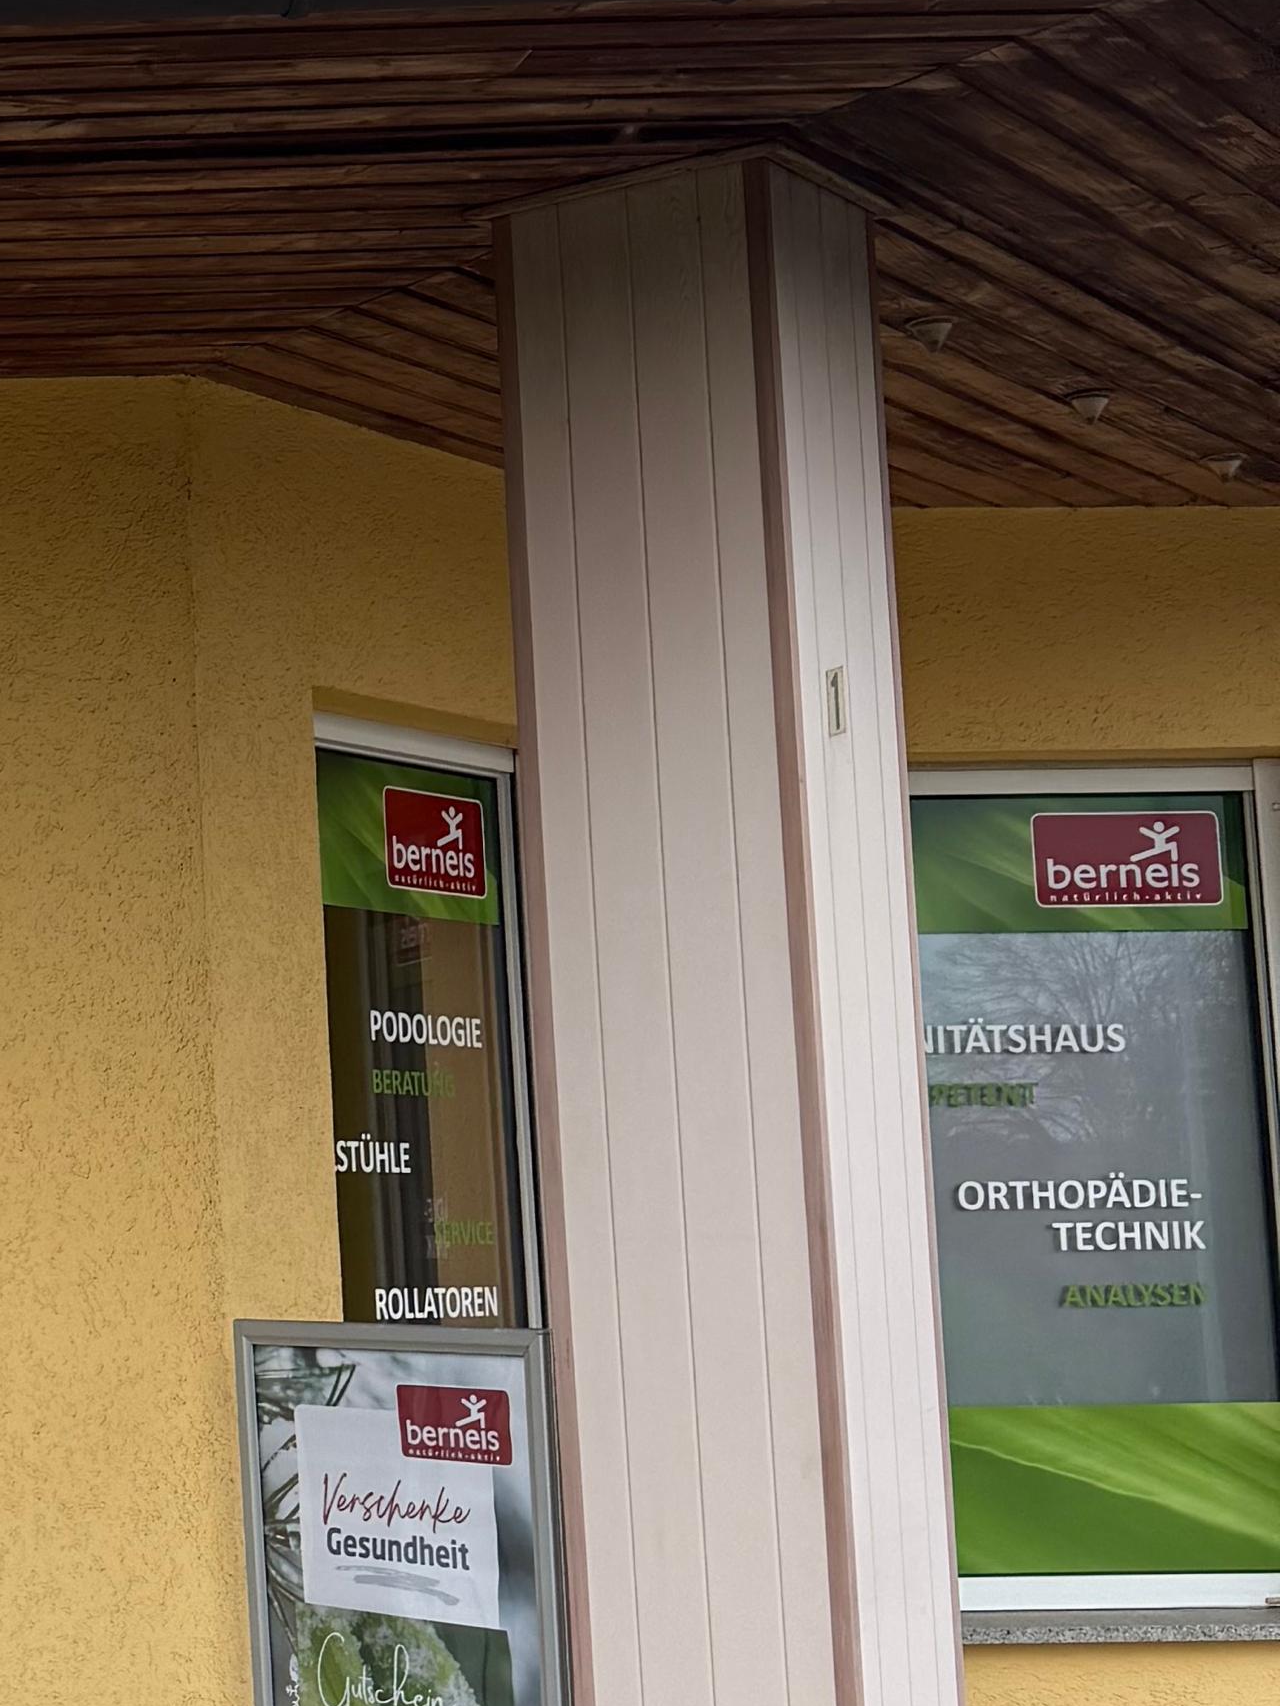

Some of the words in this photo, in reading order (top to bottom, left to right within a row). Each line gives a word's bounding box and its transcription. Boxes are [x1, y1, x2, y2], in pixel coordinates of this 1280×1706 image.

[831, 672, 841, 730] 1
[392, 835, 475, 879] berneis
[1046, 858, 1201, 890] berneis
[1050, 891, 1203, 903] natürlich-aktiv
[369, 1009, 483, 1049] PODOLOGIE
[372, 1068, 456, 1099] BERATUNG
[334, 1133, 412, 1174] STÜHLE
[957, 1171, 1203, 1211] ORTHOPÄDIE-
[434, 1219, 497, 1246] SERVICE
[1052, 1220, 1207, 1252] TECHNIK
[374, 1286, 499, 1321] ROLLATOREN
[1063, 1282, 1208, 1307] ANALYSEN
[405, 1419, 501, 1452] berneis
[322, 1472, 471, 1534] Verschenke
[326, 1526, 471, 1571] Gesundheit
